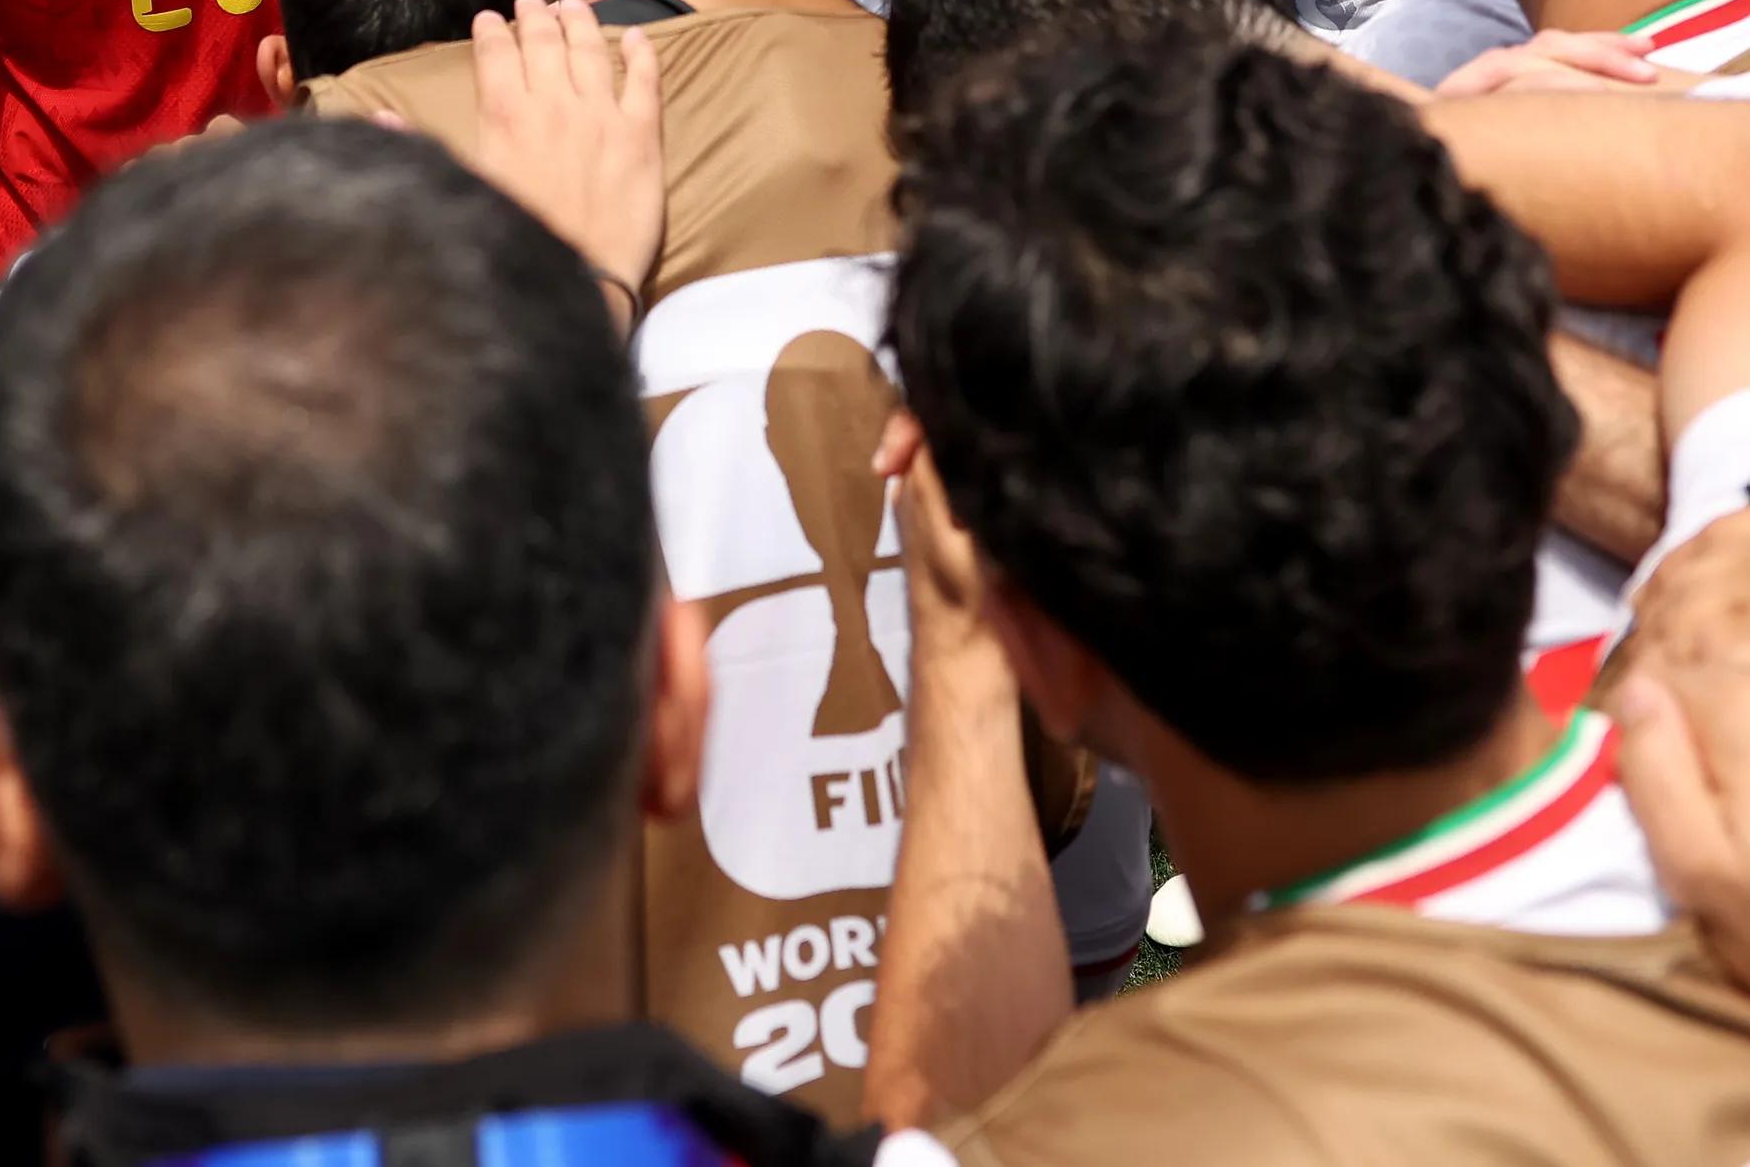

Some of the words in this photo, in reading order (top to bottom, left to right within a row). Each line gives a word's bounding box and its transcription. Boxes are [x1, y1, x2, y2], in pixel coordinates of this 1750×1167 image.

[810, 745, 906, 830] FI
[718, 914, 888, 998] WOR
[733, 979, 878, 1097] 20
